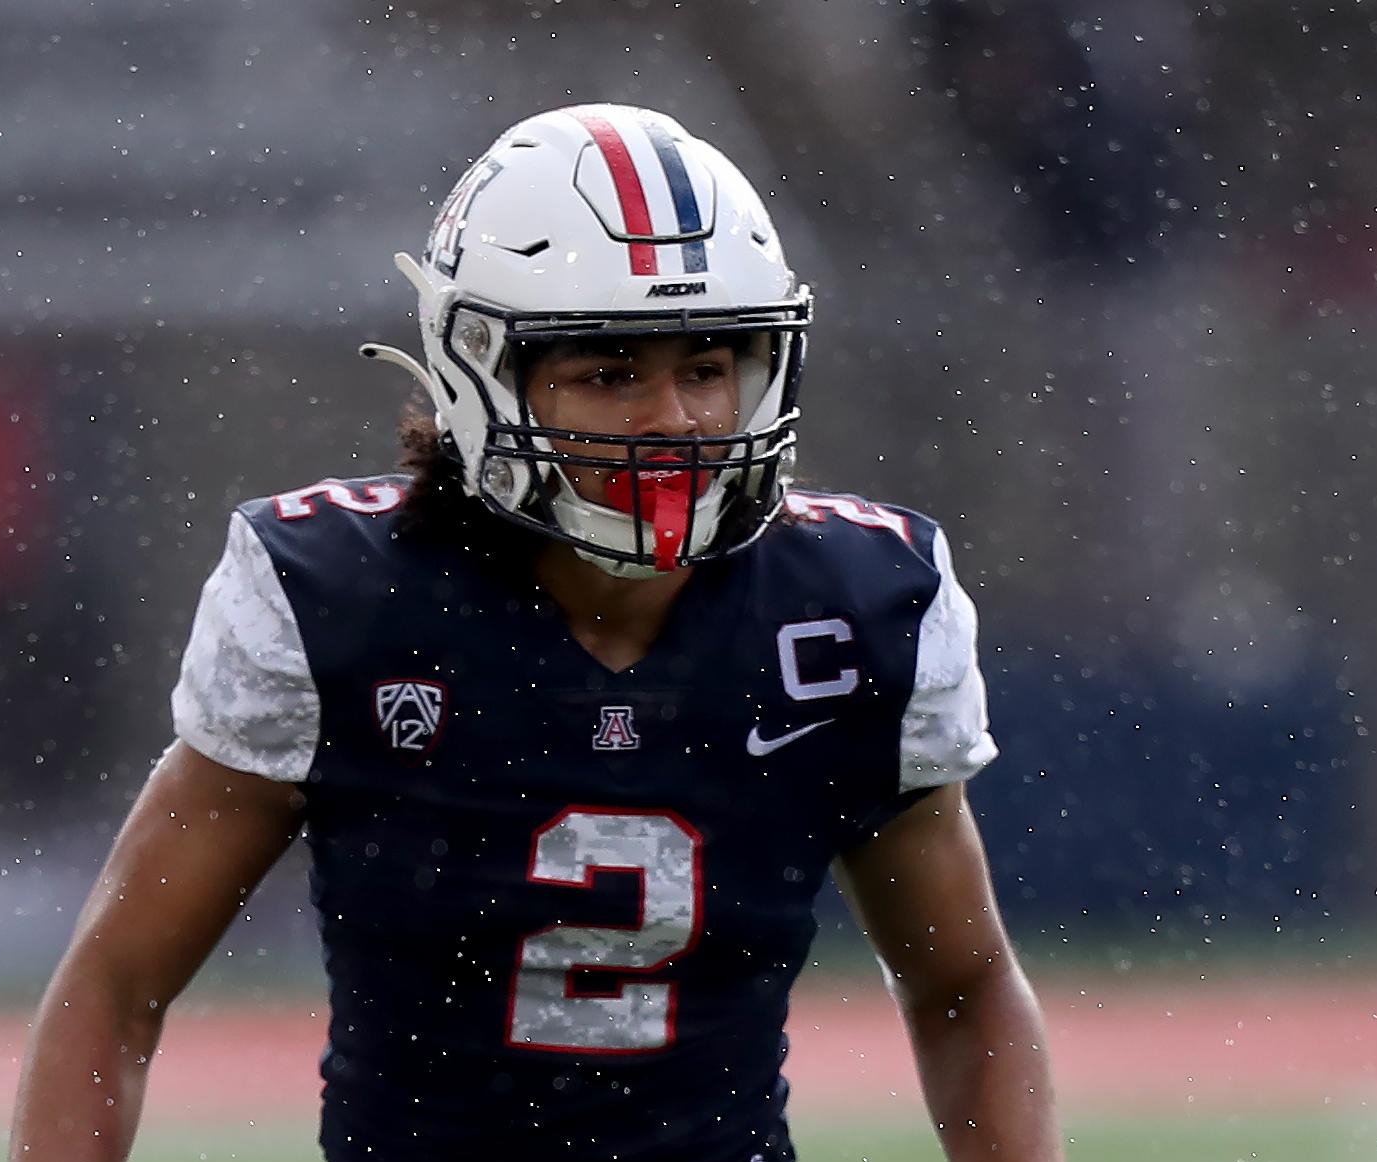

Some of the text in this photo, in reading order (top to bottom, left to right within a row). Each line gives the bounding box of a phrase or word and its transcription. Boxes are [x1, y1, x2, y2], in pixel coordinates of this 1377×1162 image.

[273, 481, 406, 520] 2
[776, 618, 859, 701] C
[376, 683, 442, 735] PAC
[592, 706, 640, 750] A
[392, 719, 425, 750] 12
[504, 804, 704, 1053] 2
